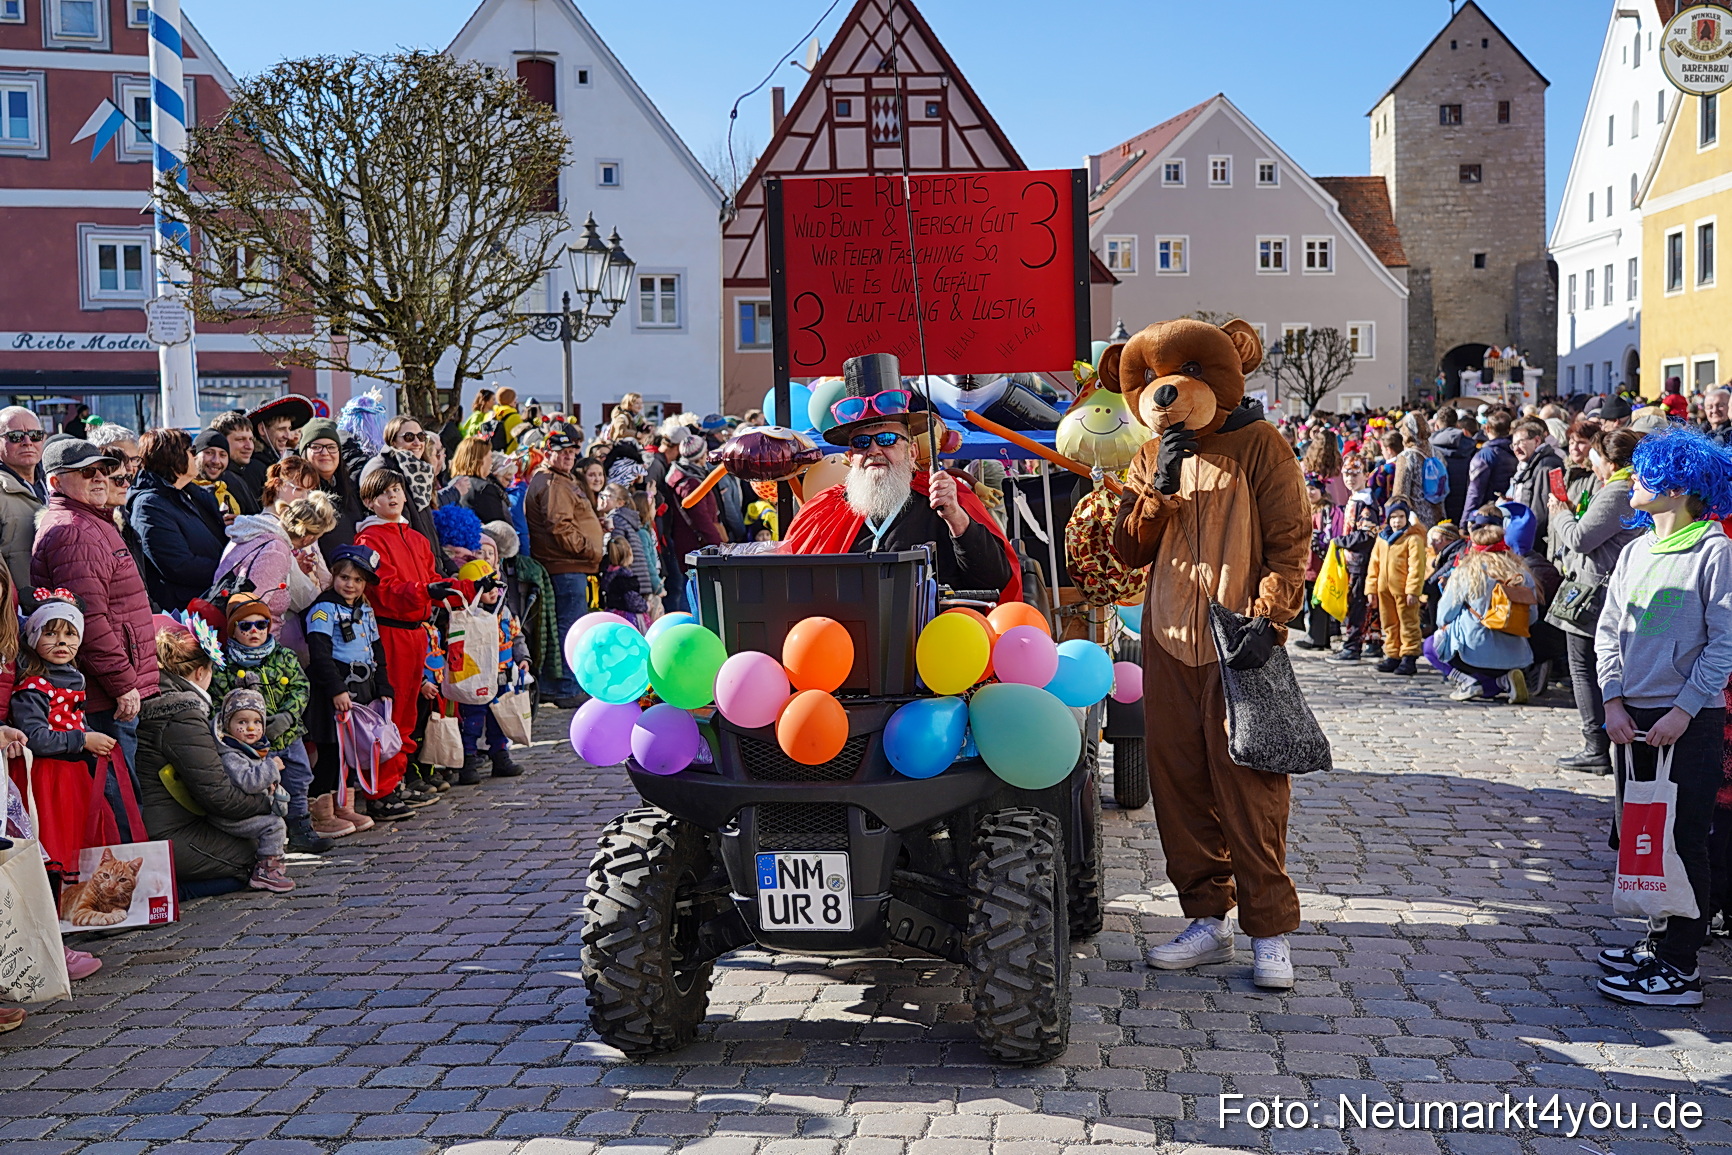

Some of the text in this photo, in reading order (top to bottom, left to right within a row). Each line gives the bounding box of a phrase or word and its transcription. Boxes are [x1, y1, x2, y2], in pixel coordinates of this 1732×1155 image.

[1691, 13, 1722, 21] WINKLER
[1683, 74, 1725, 83] BERCHING
[813, 178, 854, 209] DIE
[881, 207, 898, 237] &
[1019, 181, 1059, 269] 3
[949, 292, 964, 321] &
[12, 332, 152, 350] Riebe Moden
[793, 291, 827, 367] 3
[943, 327, 979, 361] HELAU
[764, 876, 772, 885] D
[778, 859, 824, 889] NM
[1617, 877, 1667, 892] Sparkasse
[149, 912, 168, 920] BESTES
[152, 906, 166, 914] DEIN
[768, 894, 842, 925] UR 8
